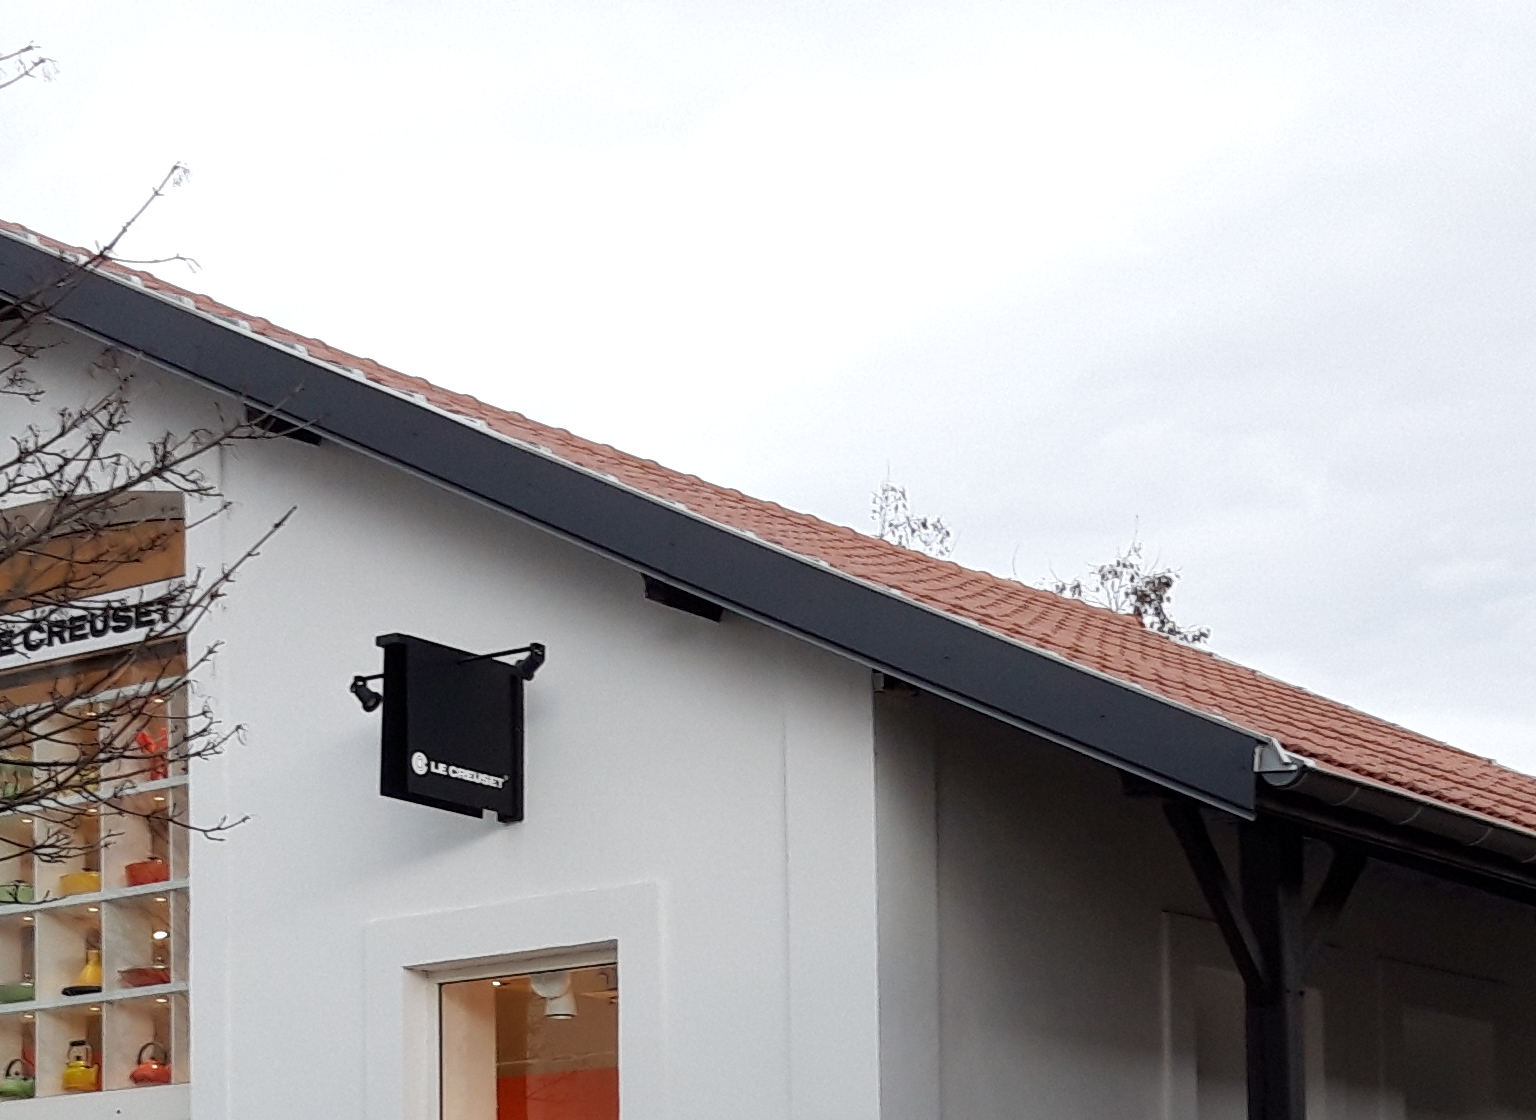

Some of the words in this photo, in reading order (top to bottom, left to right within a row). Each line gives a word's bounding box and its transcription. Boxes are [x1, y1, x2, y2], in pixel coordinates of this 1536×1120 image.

[23, 604, 170, 651] CREUSET
[430, 761, 448, 775] LE
[448, 766, 504, 789] CREUSET
